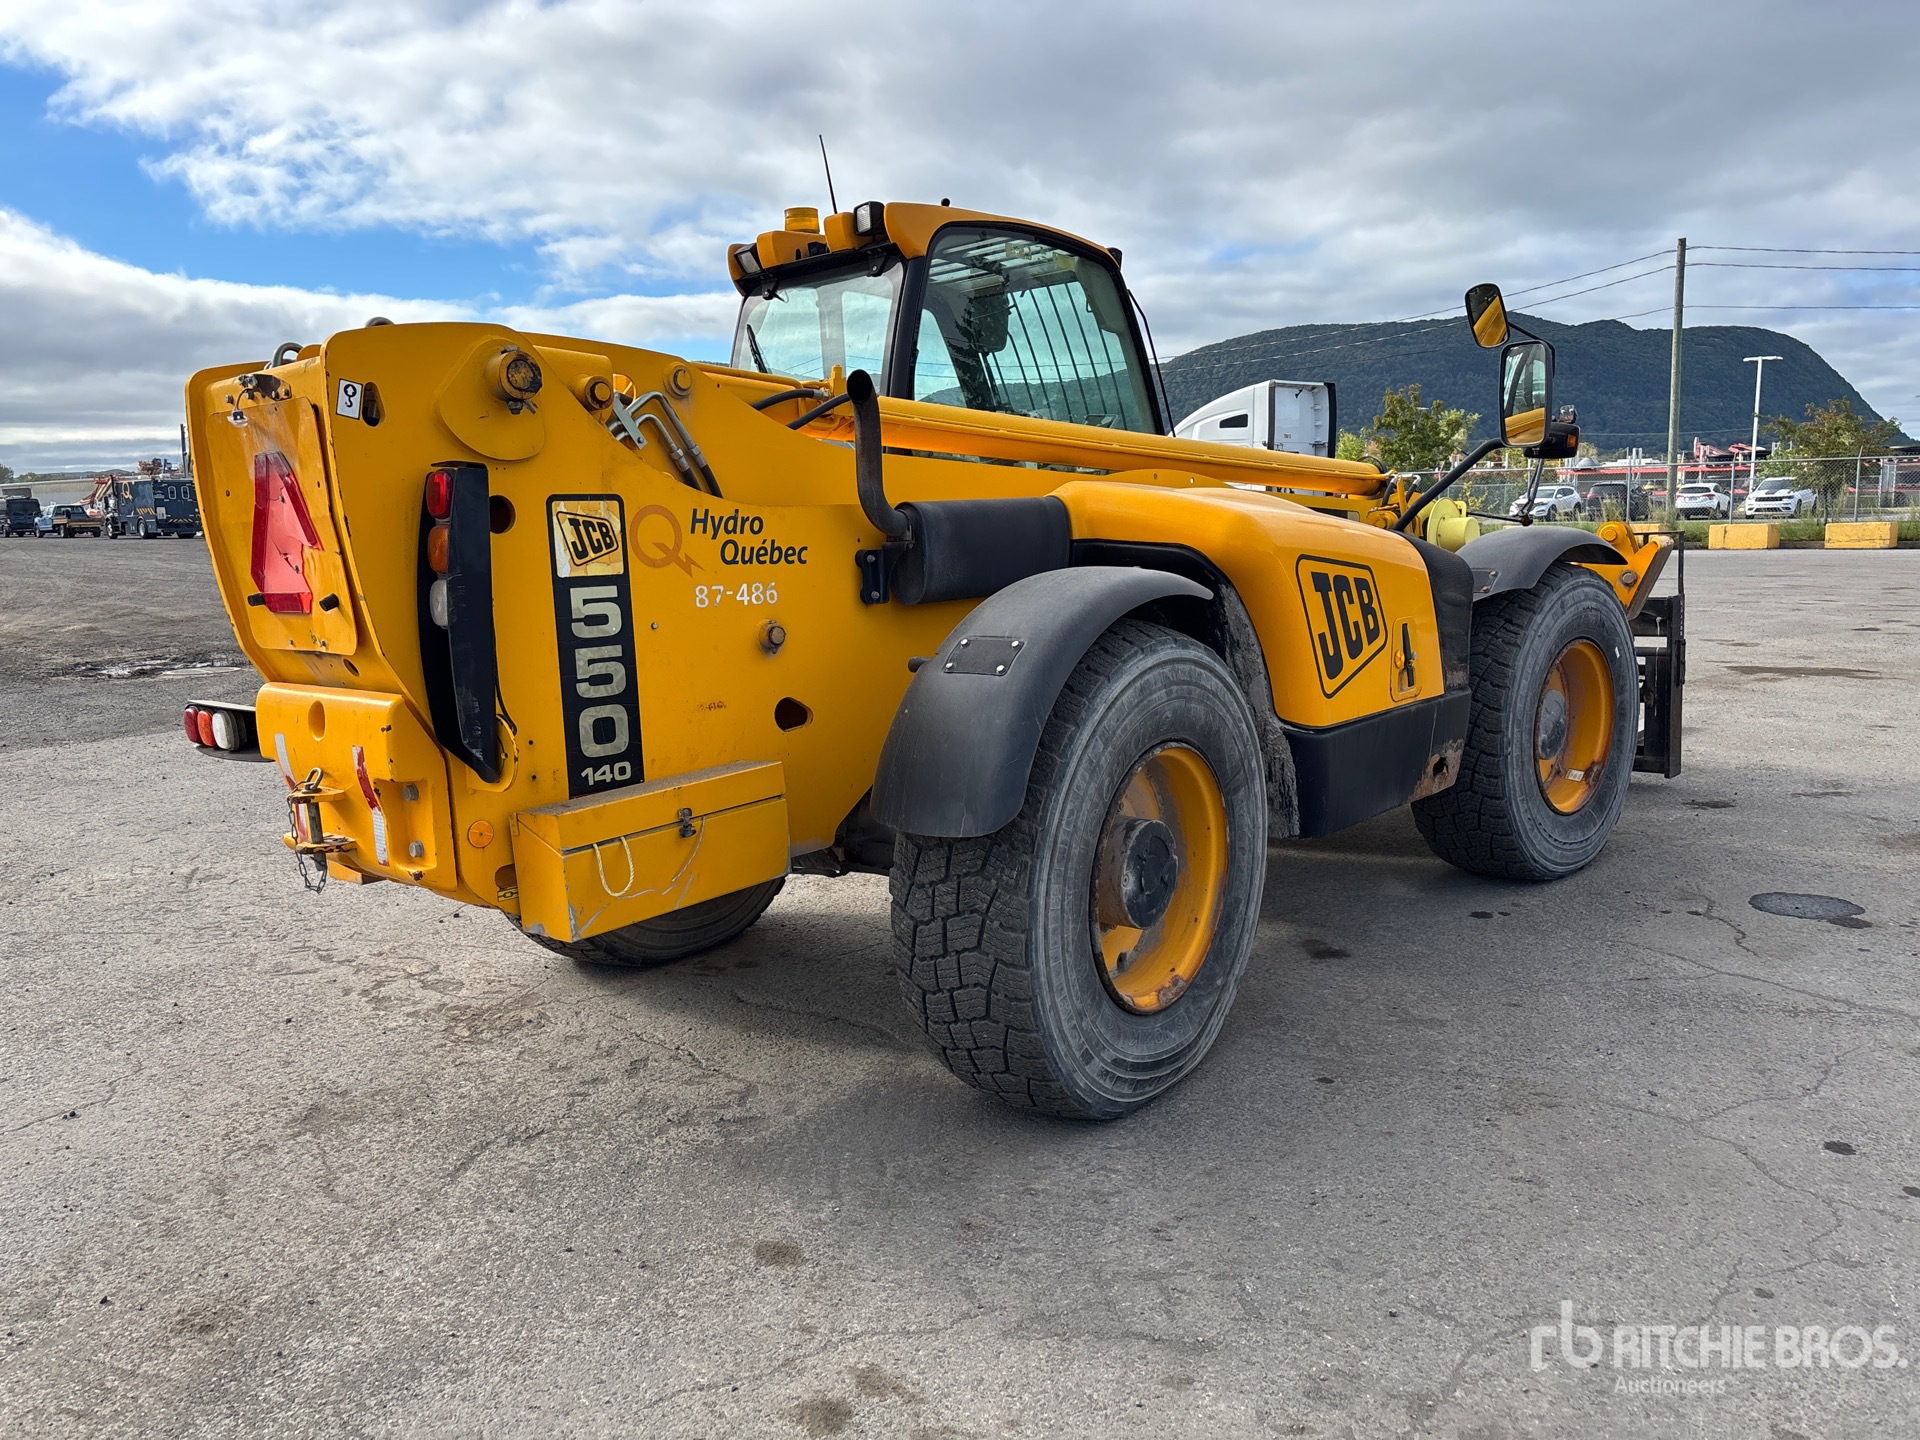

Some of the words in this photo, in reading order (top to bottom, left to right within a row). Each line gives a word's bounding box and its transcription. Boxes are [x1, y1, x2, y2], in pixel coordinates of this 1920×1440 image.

[567, 517, 615, 560] JCB
[690, 508, 764, 540] Hydro
[720, 538, 808, 566] Québec
[695, 581, 778, 608] 87-486
[1311, 571, 1380, 680] JCB
[581, 761, 632, 786] 140
